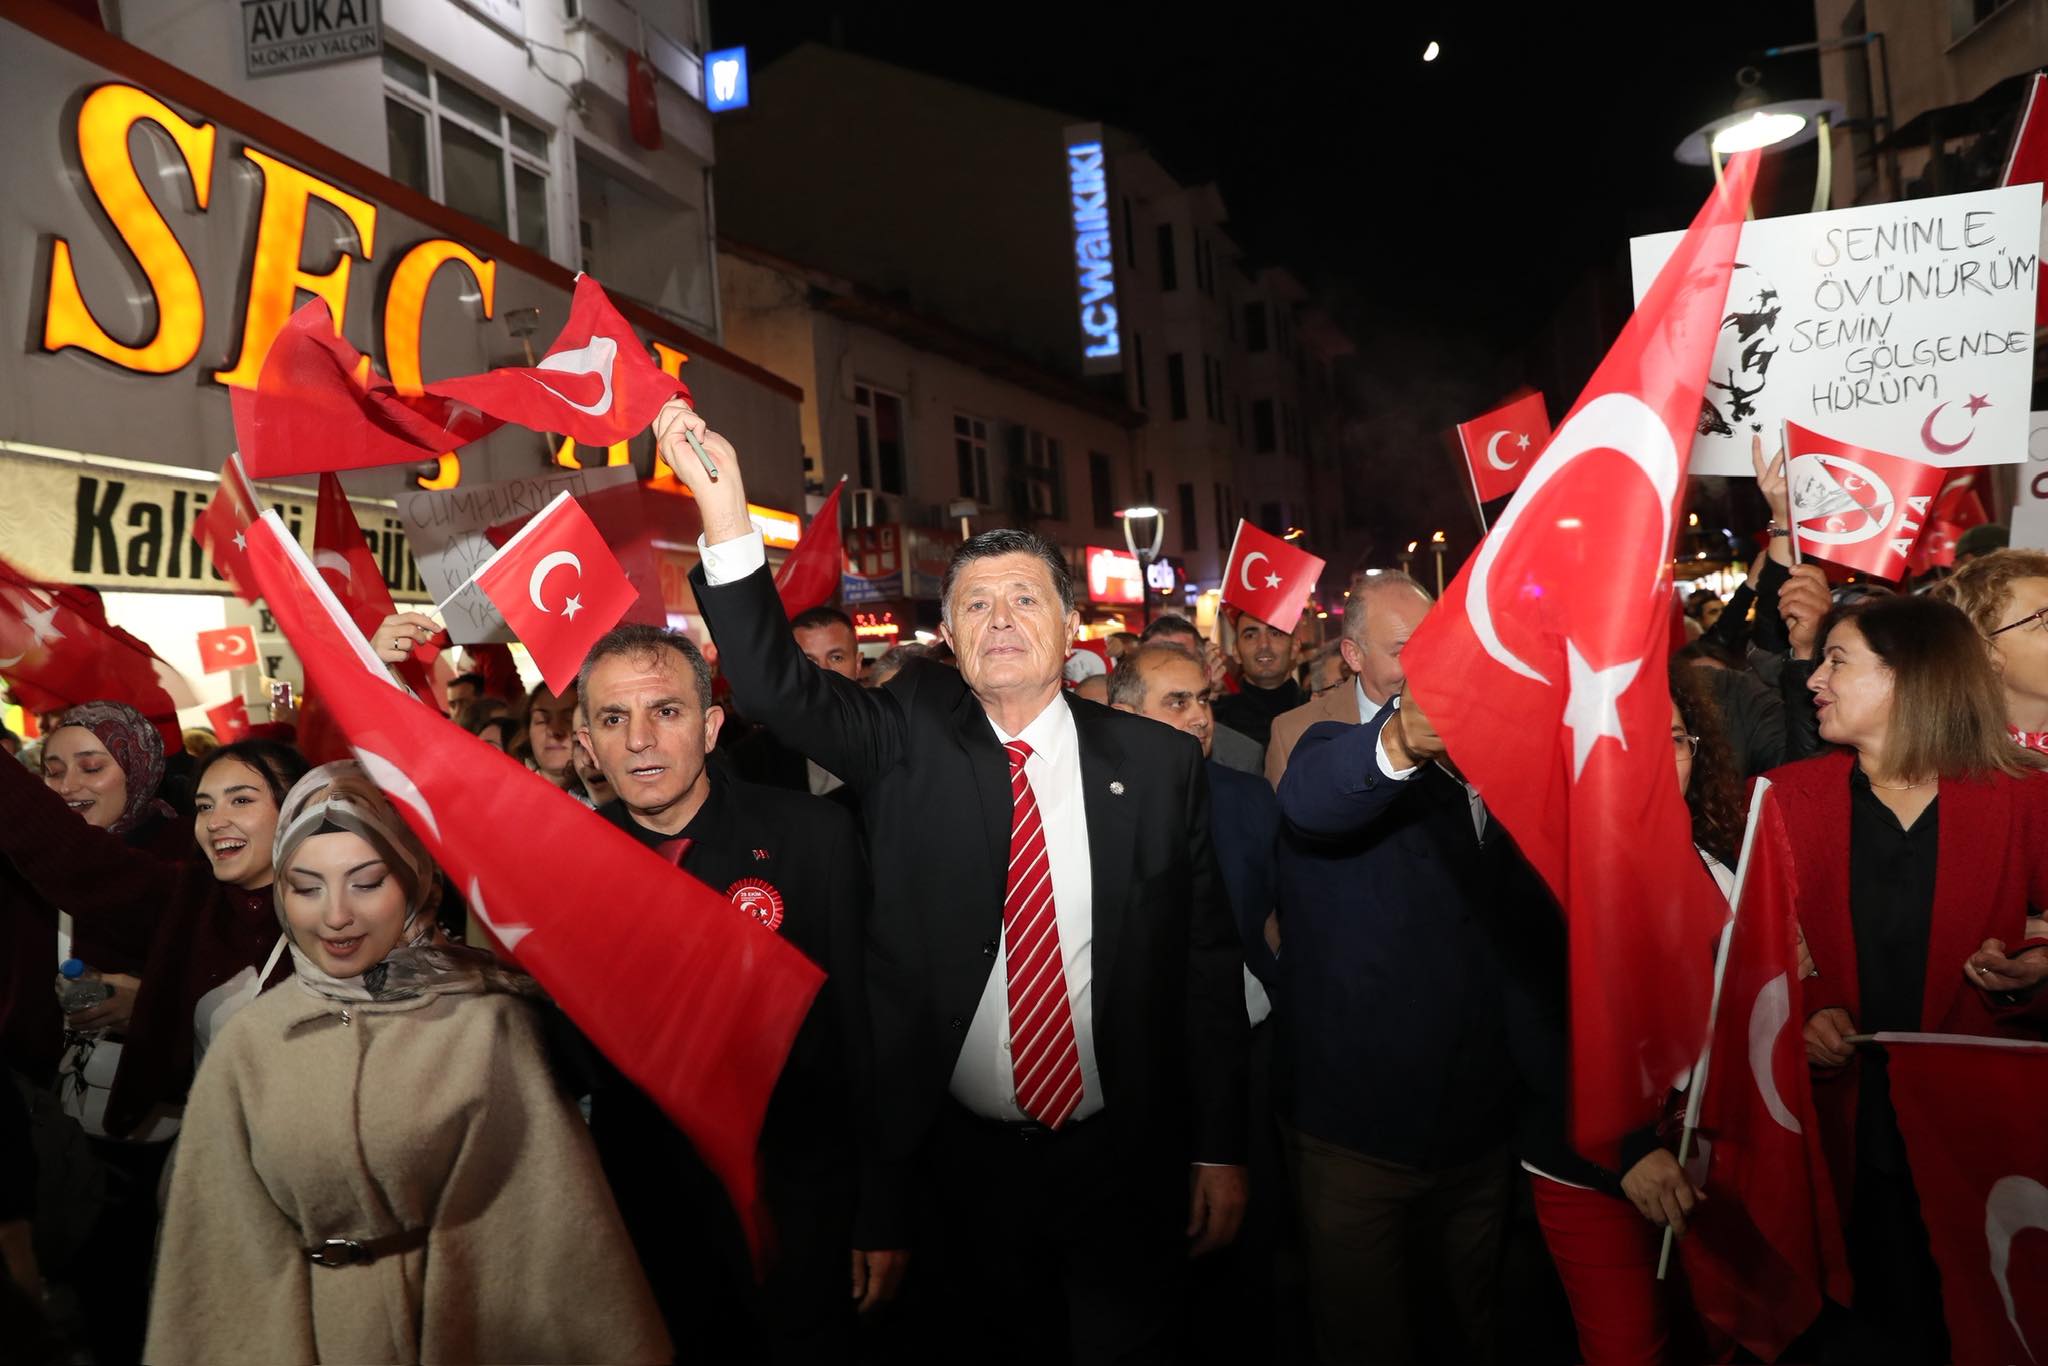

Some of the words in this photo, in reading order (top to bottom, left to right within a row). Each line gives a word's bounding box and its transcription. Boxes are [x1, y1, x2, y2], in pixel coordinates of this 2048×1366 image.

[1812, 211, 1996, 267] SENİNLE
[1814, 247, 2036, 311] ÖVÜNÜRÜM
[1789, 312, 1892, 352] SENİN
[1845, 331, 2030, 382] GÖLGENDE
[1812, 372, 1938, 416] HÜRÜM
[1888, 496, 1932, 559] ATA
